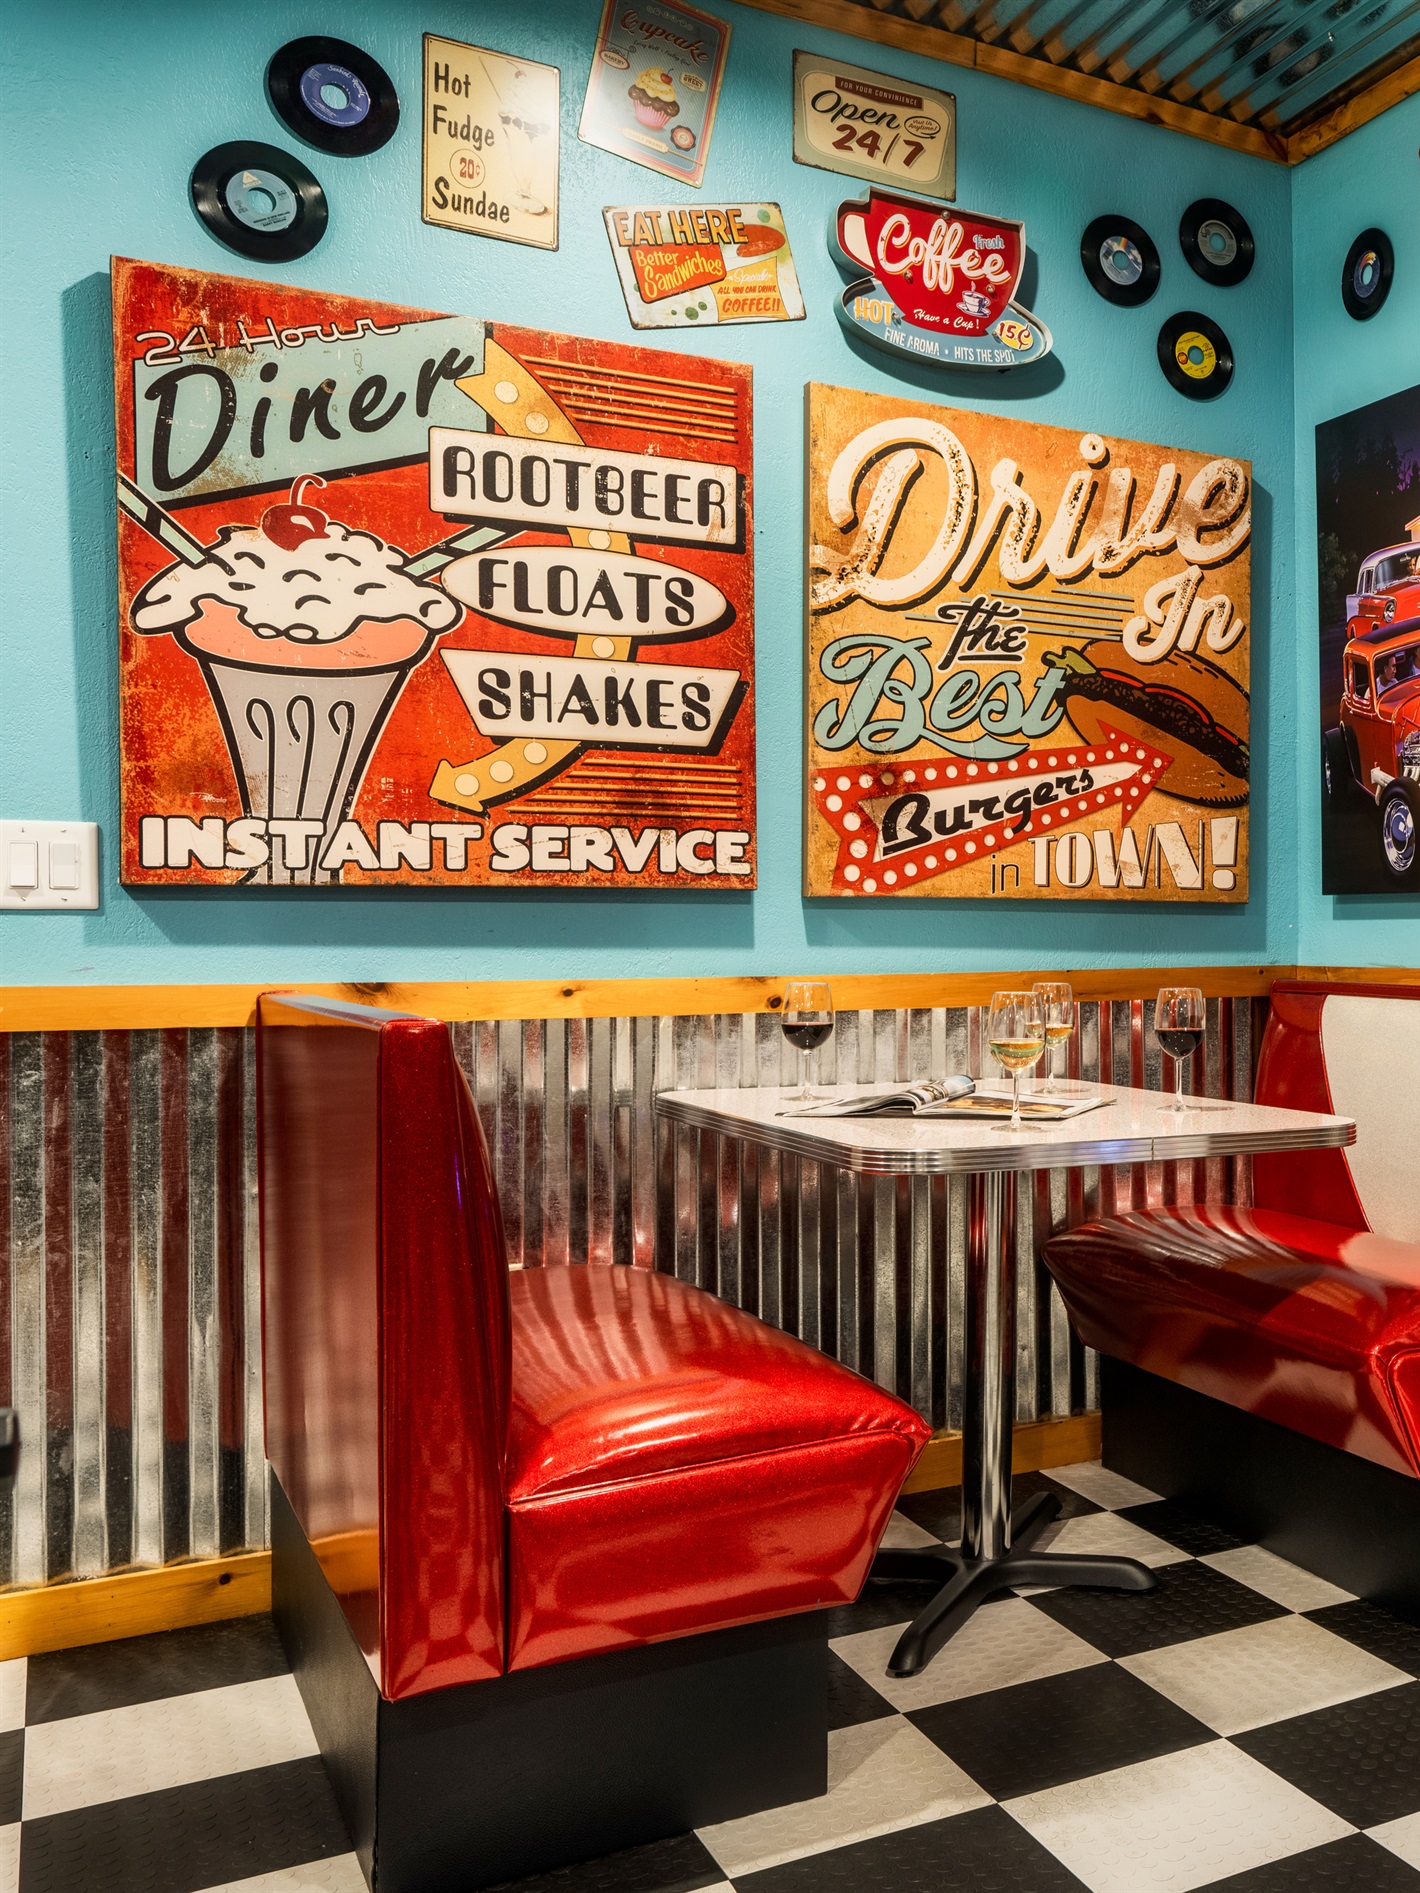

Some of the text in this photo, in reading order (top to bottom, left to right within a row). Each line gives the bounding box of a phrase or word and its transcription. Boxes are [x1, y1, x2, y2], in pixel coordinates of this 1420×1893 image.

[621, 9, 709, 67] Cupcake
[434, 62, 471, 98] Hot
[840, 80, 853, 90] FOR
[855, 84, 873, 95] YOUR
[433, 104, 495, 151] Fudge
[811, 90, 901, 130] Open
[459, 157, 481, 180] 20¢
[832, 124, 925, 167] 24/7
[432, 176, 510, 224] Sundae
[613, 208, 749, 247] EAT HERE
[973, 234, 1005, 250] Fresh
[635, 250, 679, 267] Better
[644, 251, 723, 298] Sandwiches
[877, 213, 1012, 294] Coffee
[717, 285, 777, 295] ALL YOU CAN DRINK
[722, 297, 781, 313] COFFEE!!
[853, 296, 895, 326] HOT
[913, 309, 940, 323] Have
[942, 317, 950, 325] a
[999, 322, 1031, 350] 15¢
[136, 319, 400, 367] 24 Hour
[884, 327, 905, 347] FINE
[907, 335, 940, 356] AROMA
[954, 346, 975, 362] HITS
[976, 348, 993, 363] THE
[145, 347, 474, 493] Diner
[442, 445, 728, 530] ROOTBEER
[811, 417, 1251, 610] Drive
[477, 557, 696, 627] FLOATS
[1122, 565, 1246, 665] In
[477, 667, 713, 732] SHAKES
[814, 634, 1067, 761] Best
[883, 769, 1095, 856] Burgers
[138, 815, 753, 875] INSTANT SERVICE
[990, 816, 1238, 896] in TOWN!
